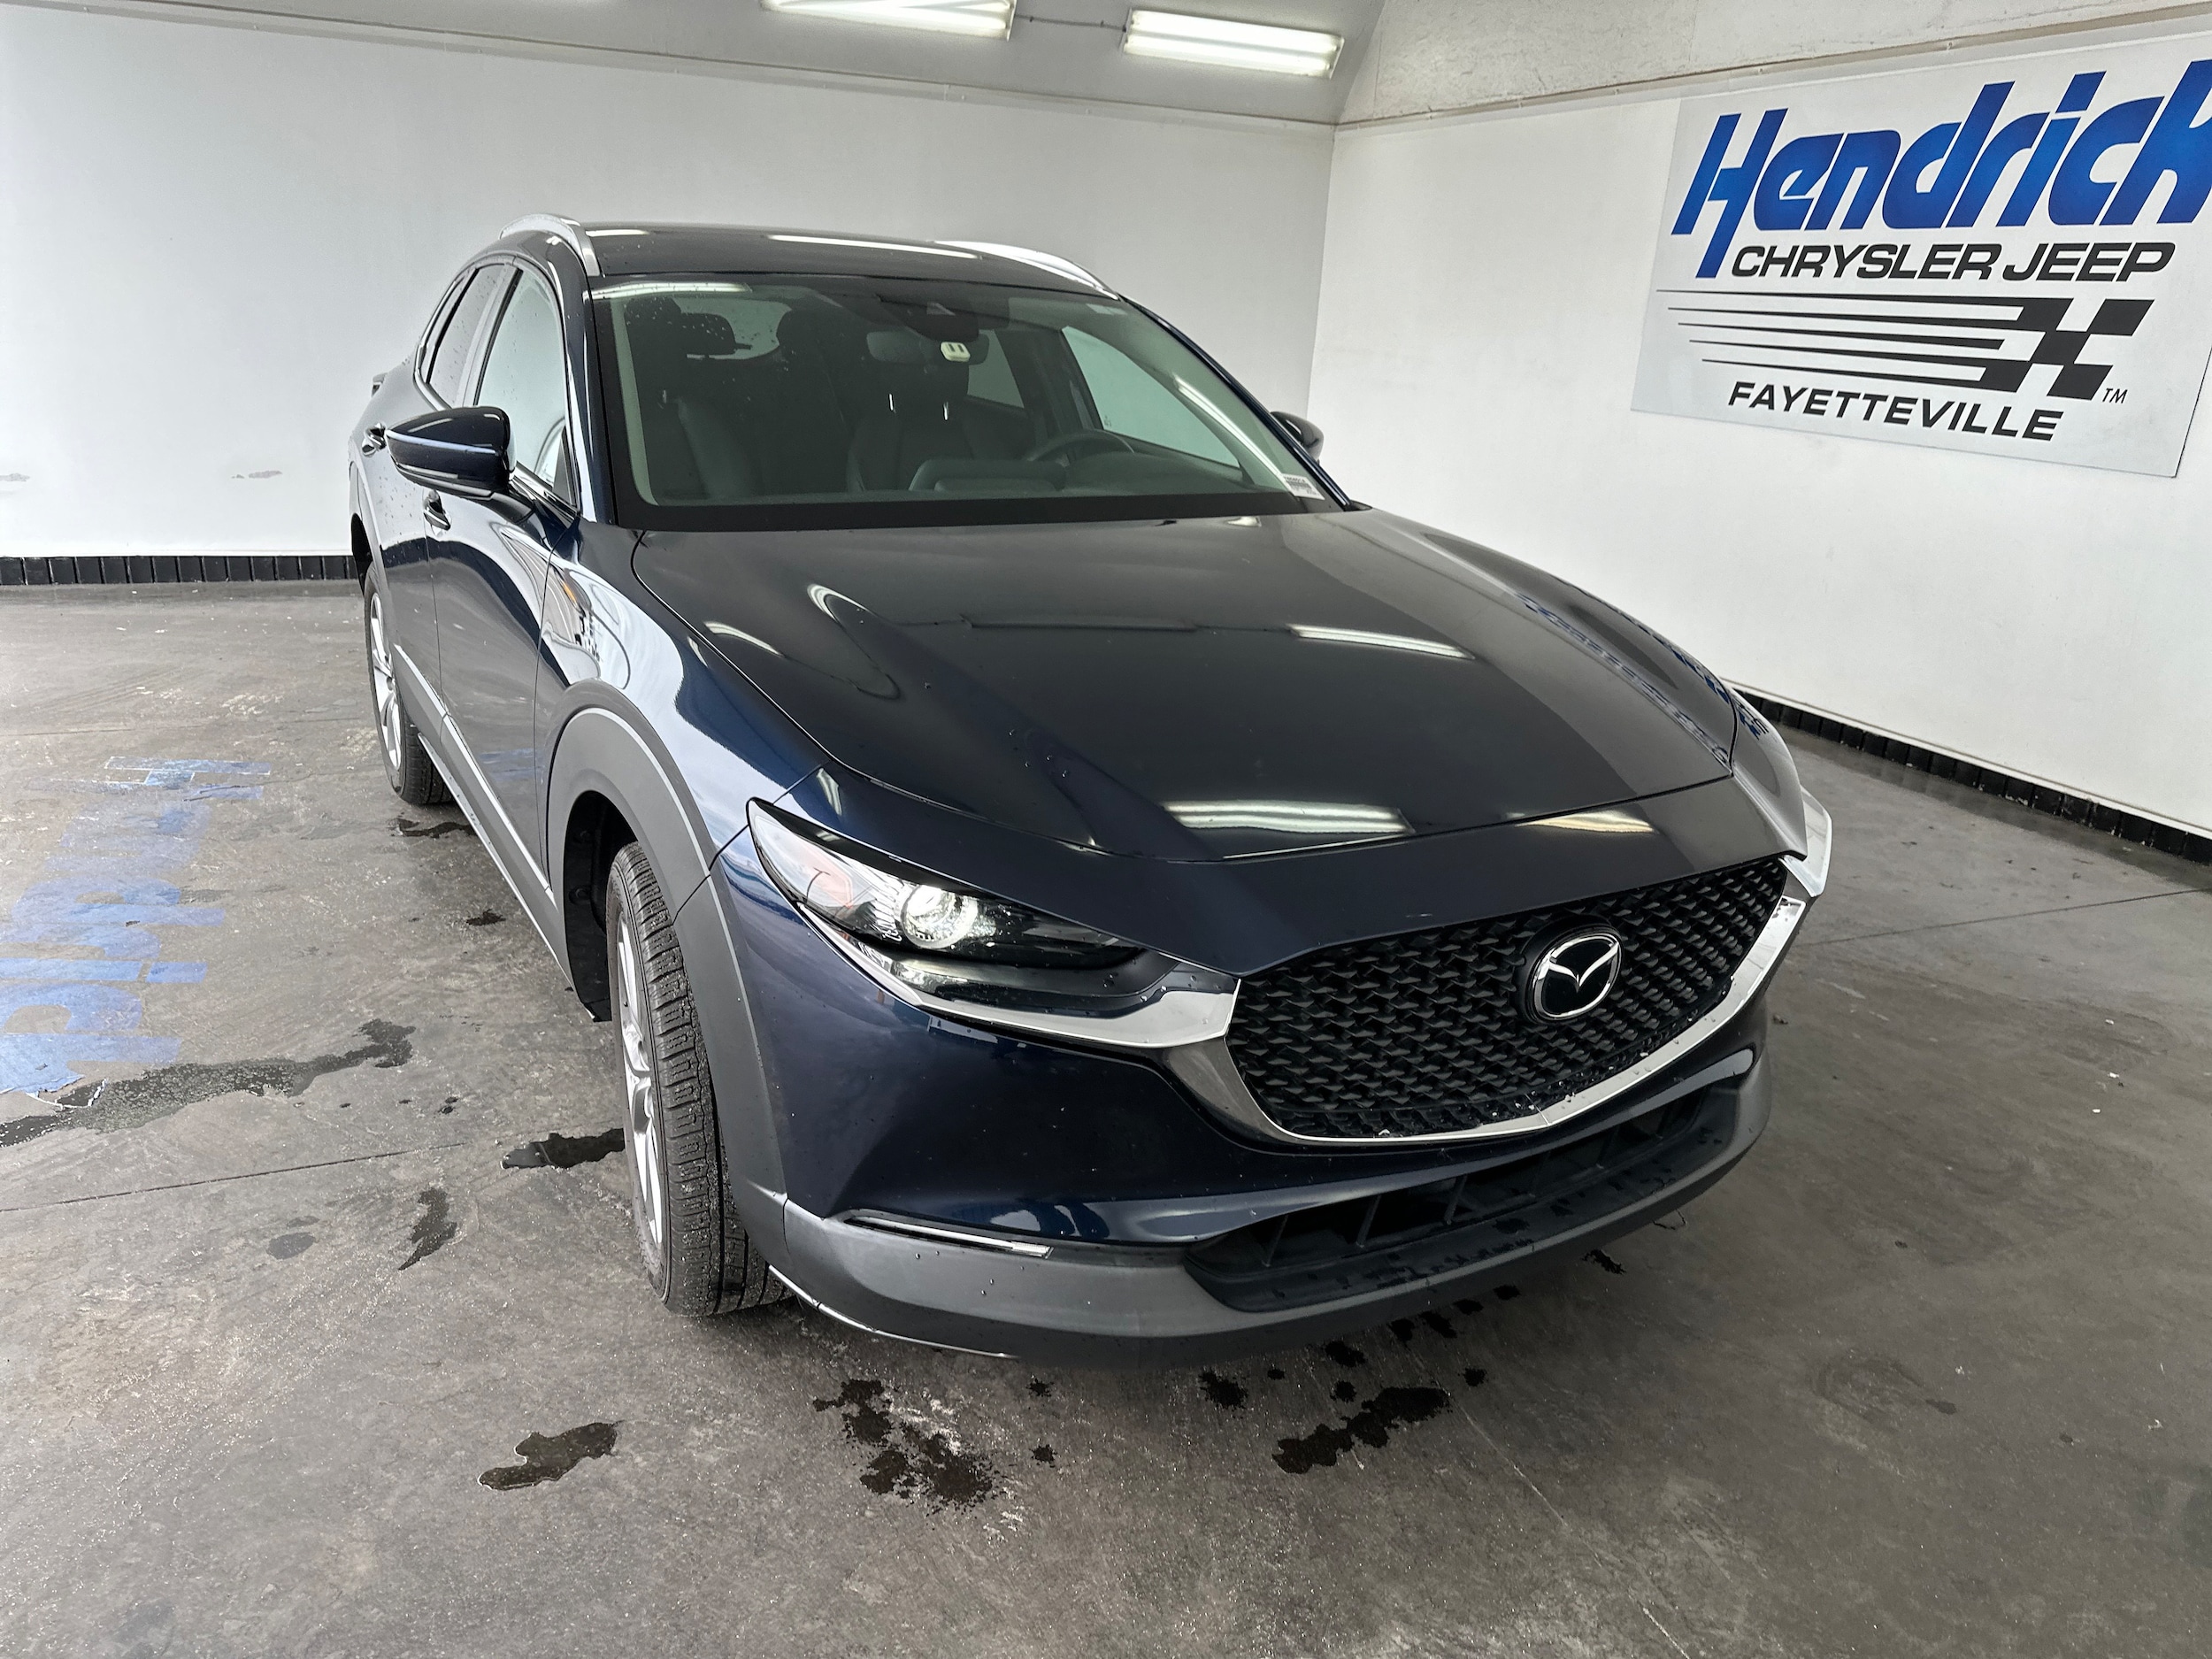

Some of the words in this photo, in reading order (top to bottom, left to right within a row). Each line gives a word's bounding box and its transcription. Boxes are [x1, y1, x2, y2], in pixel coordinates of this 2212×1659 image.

[1671, 59, 2212, 278] Hendrick
[1732, 243, 2002, 280] CHRYSLER
[2002, 242, 2176, 282] JEEP
[1728, 380, 2064, 442] FAYETTEVILLE
[2102, 388, 2128, 403] TM
